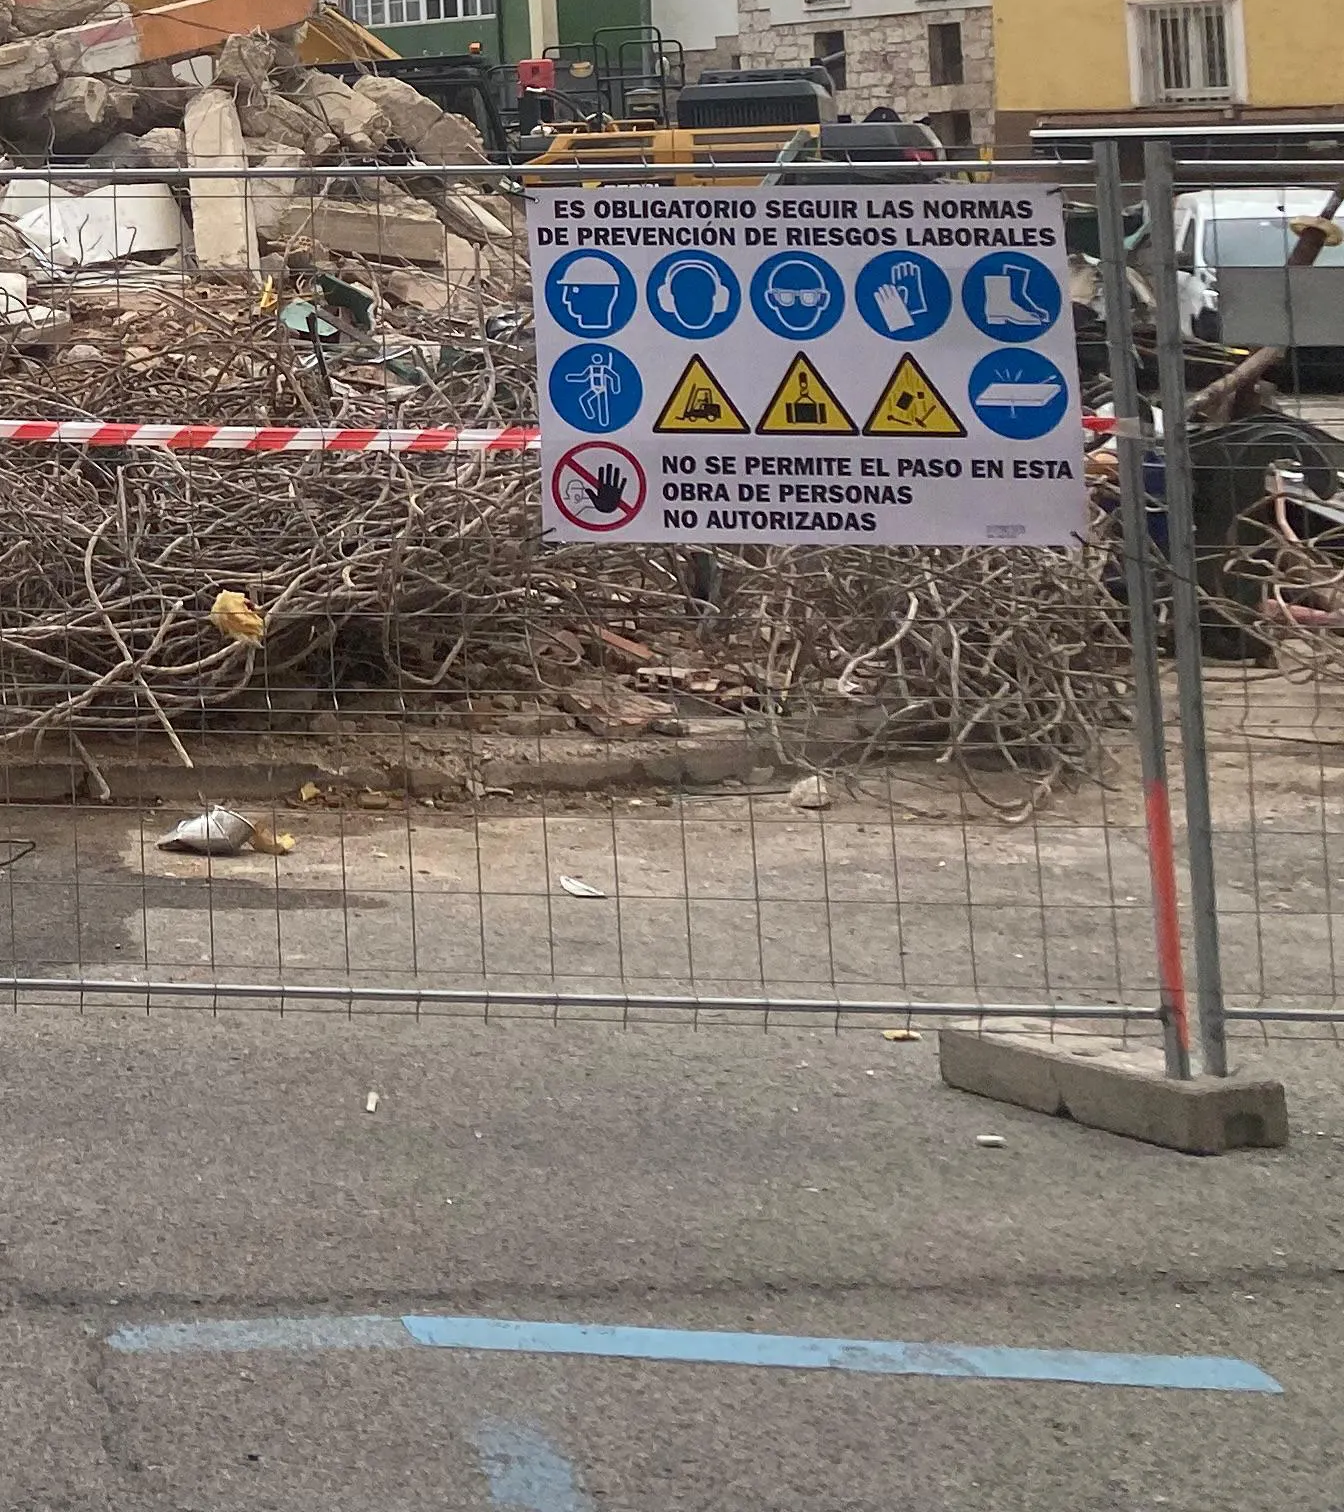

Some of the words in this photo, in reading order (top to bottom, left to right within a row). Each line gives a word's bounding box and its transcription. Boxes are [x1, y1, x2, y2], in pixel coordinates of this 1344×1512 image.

[554, 200, 586, 219] ES
[594, 200, 757, 219] OBLIGATORIO
[765, 200, 858, 219] SEGUIR
[866, 200, 914, 219] LAS
[923, 200, 1033, 220] NORMAS
[537, 227, 570, 246] DE
[577, 221, 736, 246] PREVENCIÓN
[745, 227, 778, 246] DE
[786, 227, 897, 247] RIESGOS
[906, 227, 1057, 247] LABORALES
[662, 455, 697, 475] NO
[704, 456, 736, 475] SE
[745, 456, 852, 477] PERMITE
[860, 458, 890, 477] EL
[898, 458, 962, 478] PASO
[971, 459, 1004, 479] EN
[1013, 460, 1074, 480] ESTA
[662, 482, 730, 502] OBRA
[738, 483, 771, 503] DE
[779, 484, 912, 505] PERSONAS
[663, 509, 699, 529] NO
[706, 510, 877, 532] AUTORIZADAS
